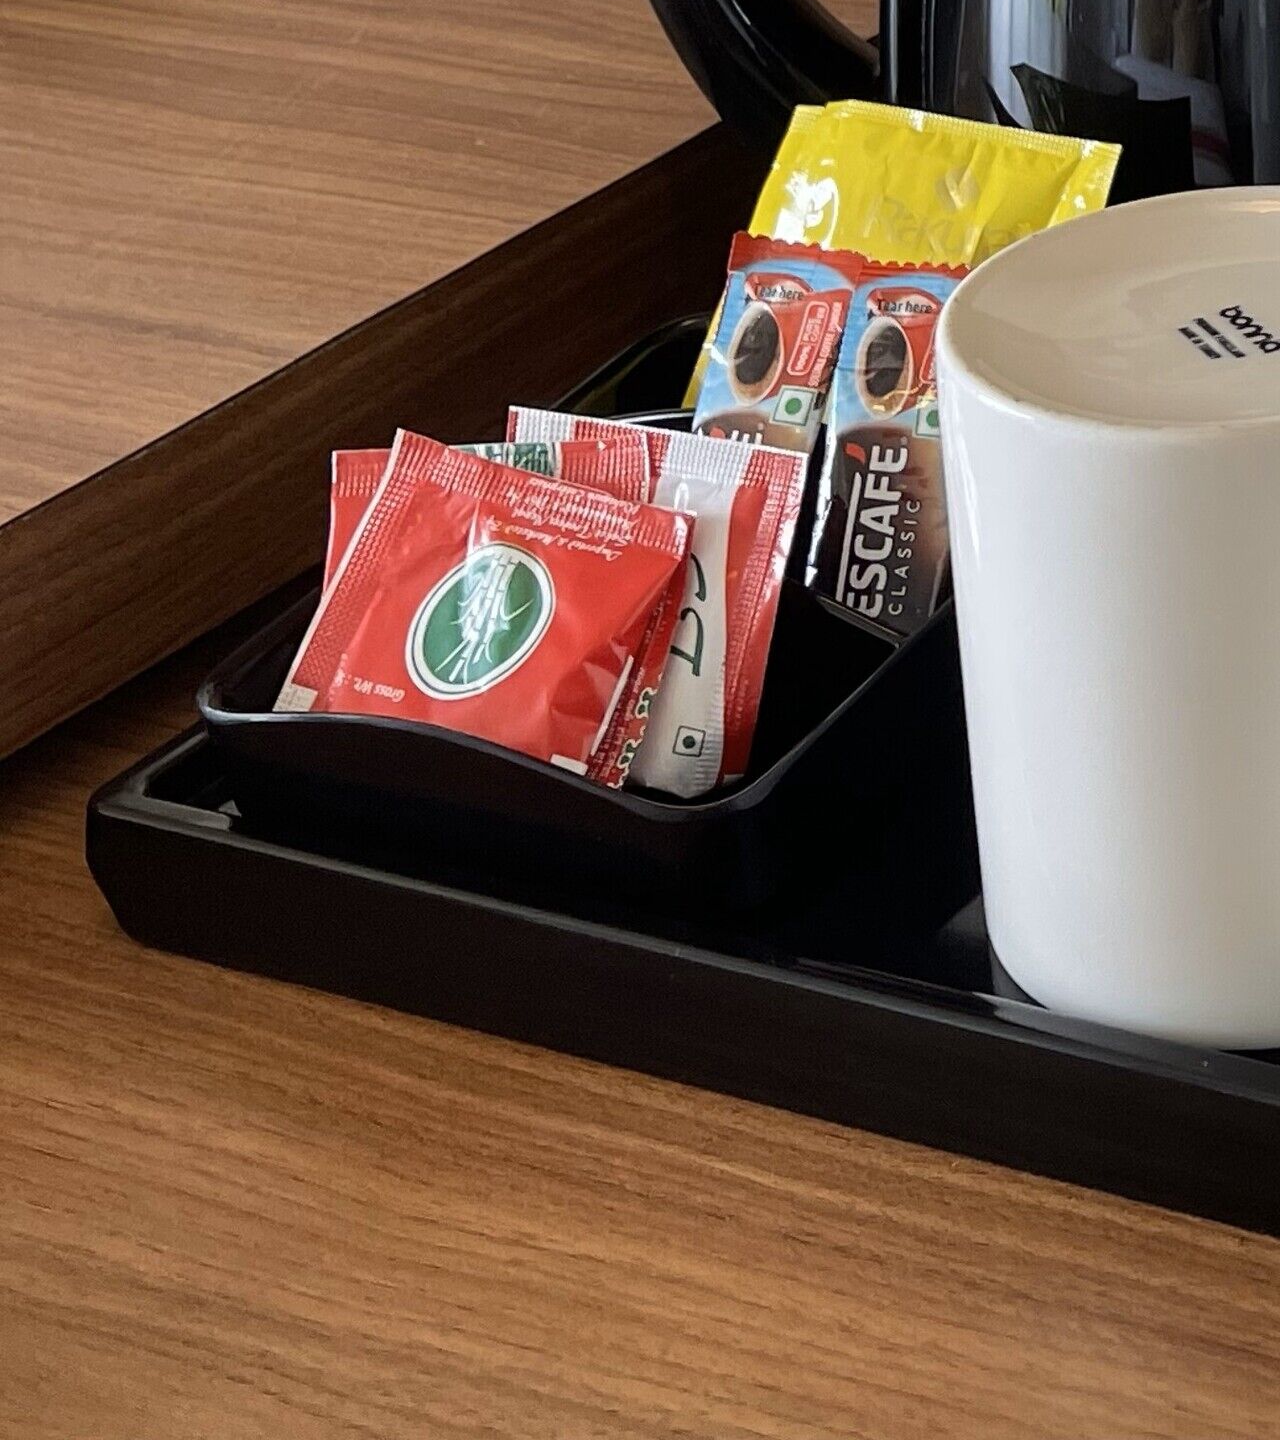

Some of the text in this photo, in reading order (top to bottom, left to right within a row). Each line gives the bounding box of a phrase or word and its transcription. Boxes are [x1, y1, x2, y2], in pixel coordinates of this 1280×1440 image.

[780, 286, 804, 301] here
[876, 297, 933, 314] Tear here
[888, 499, 922, 616] CLASSIC
